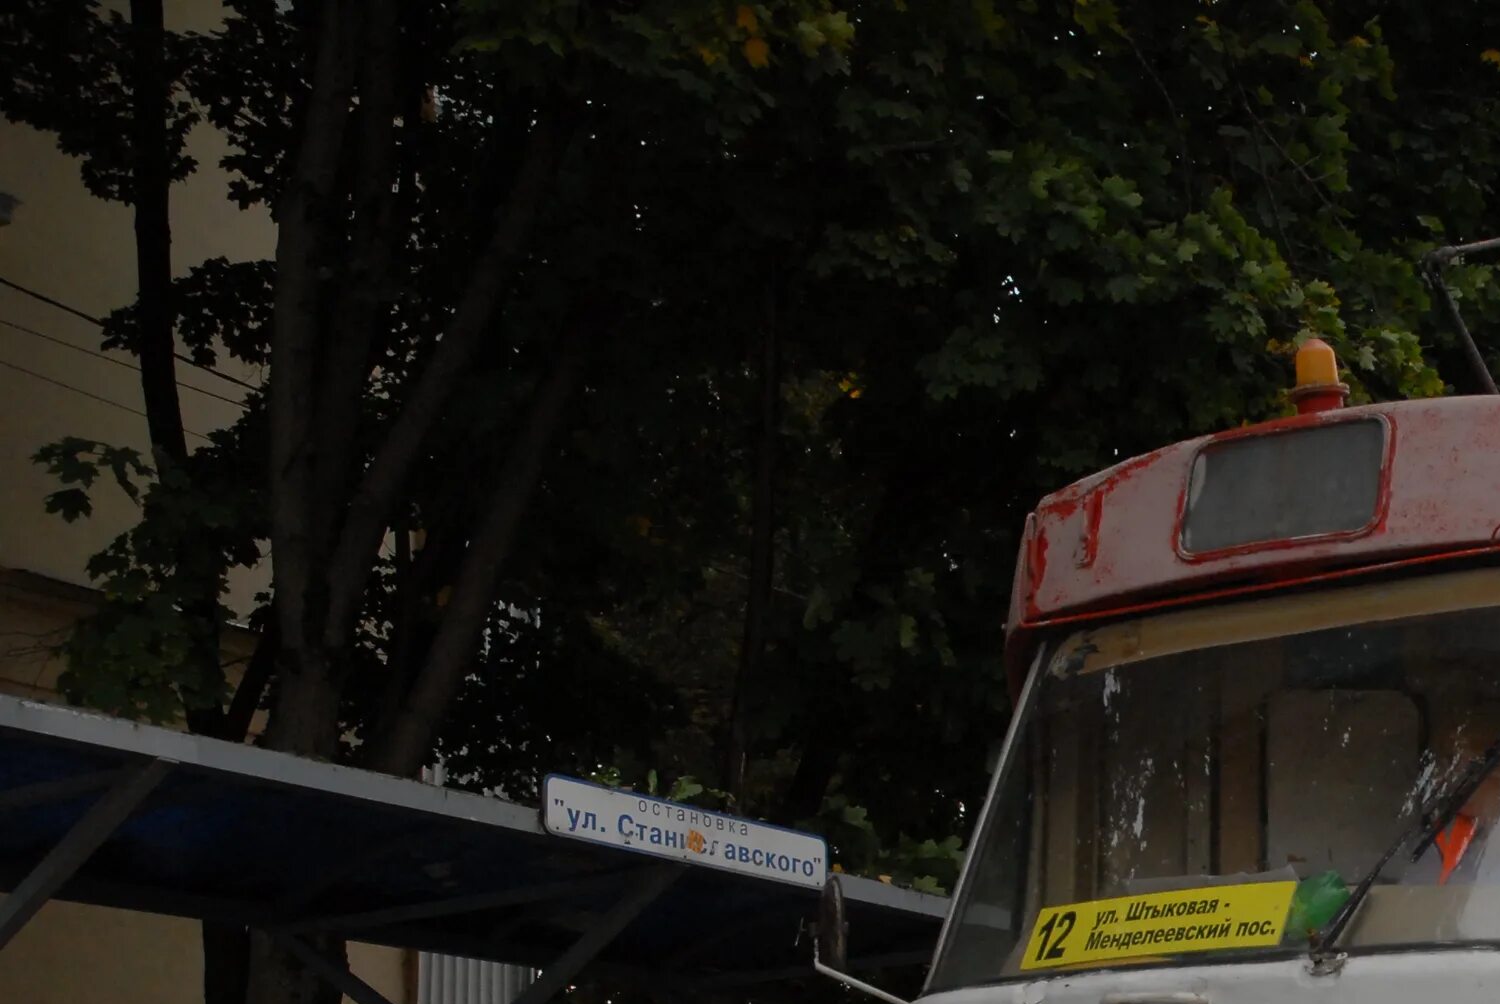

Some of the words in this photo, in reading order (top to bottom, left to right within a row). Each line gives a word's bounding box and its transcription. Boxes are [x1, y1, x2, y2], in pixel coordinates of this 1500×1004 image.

[637, 799, 749, 836] остановка
[554, 798, 606, 833] "ул.
[617, 814, 821, 877] Станавского"
[1094, 910, 1119, 930] ул.
[1125, 898, 1219, 922] Штыковая
[1035, 911, 1077, 961] 12
[1084, 918, 1232, 951] Менделеевский
[1235, 919, 1276, 937] пос.
